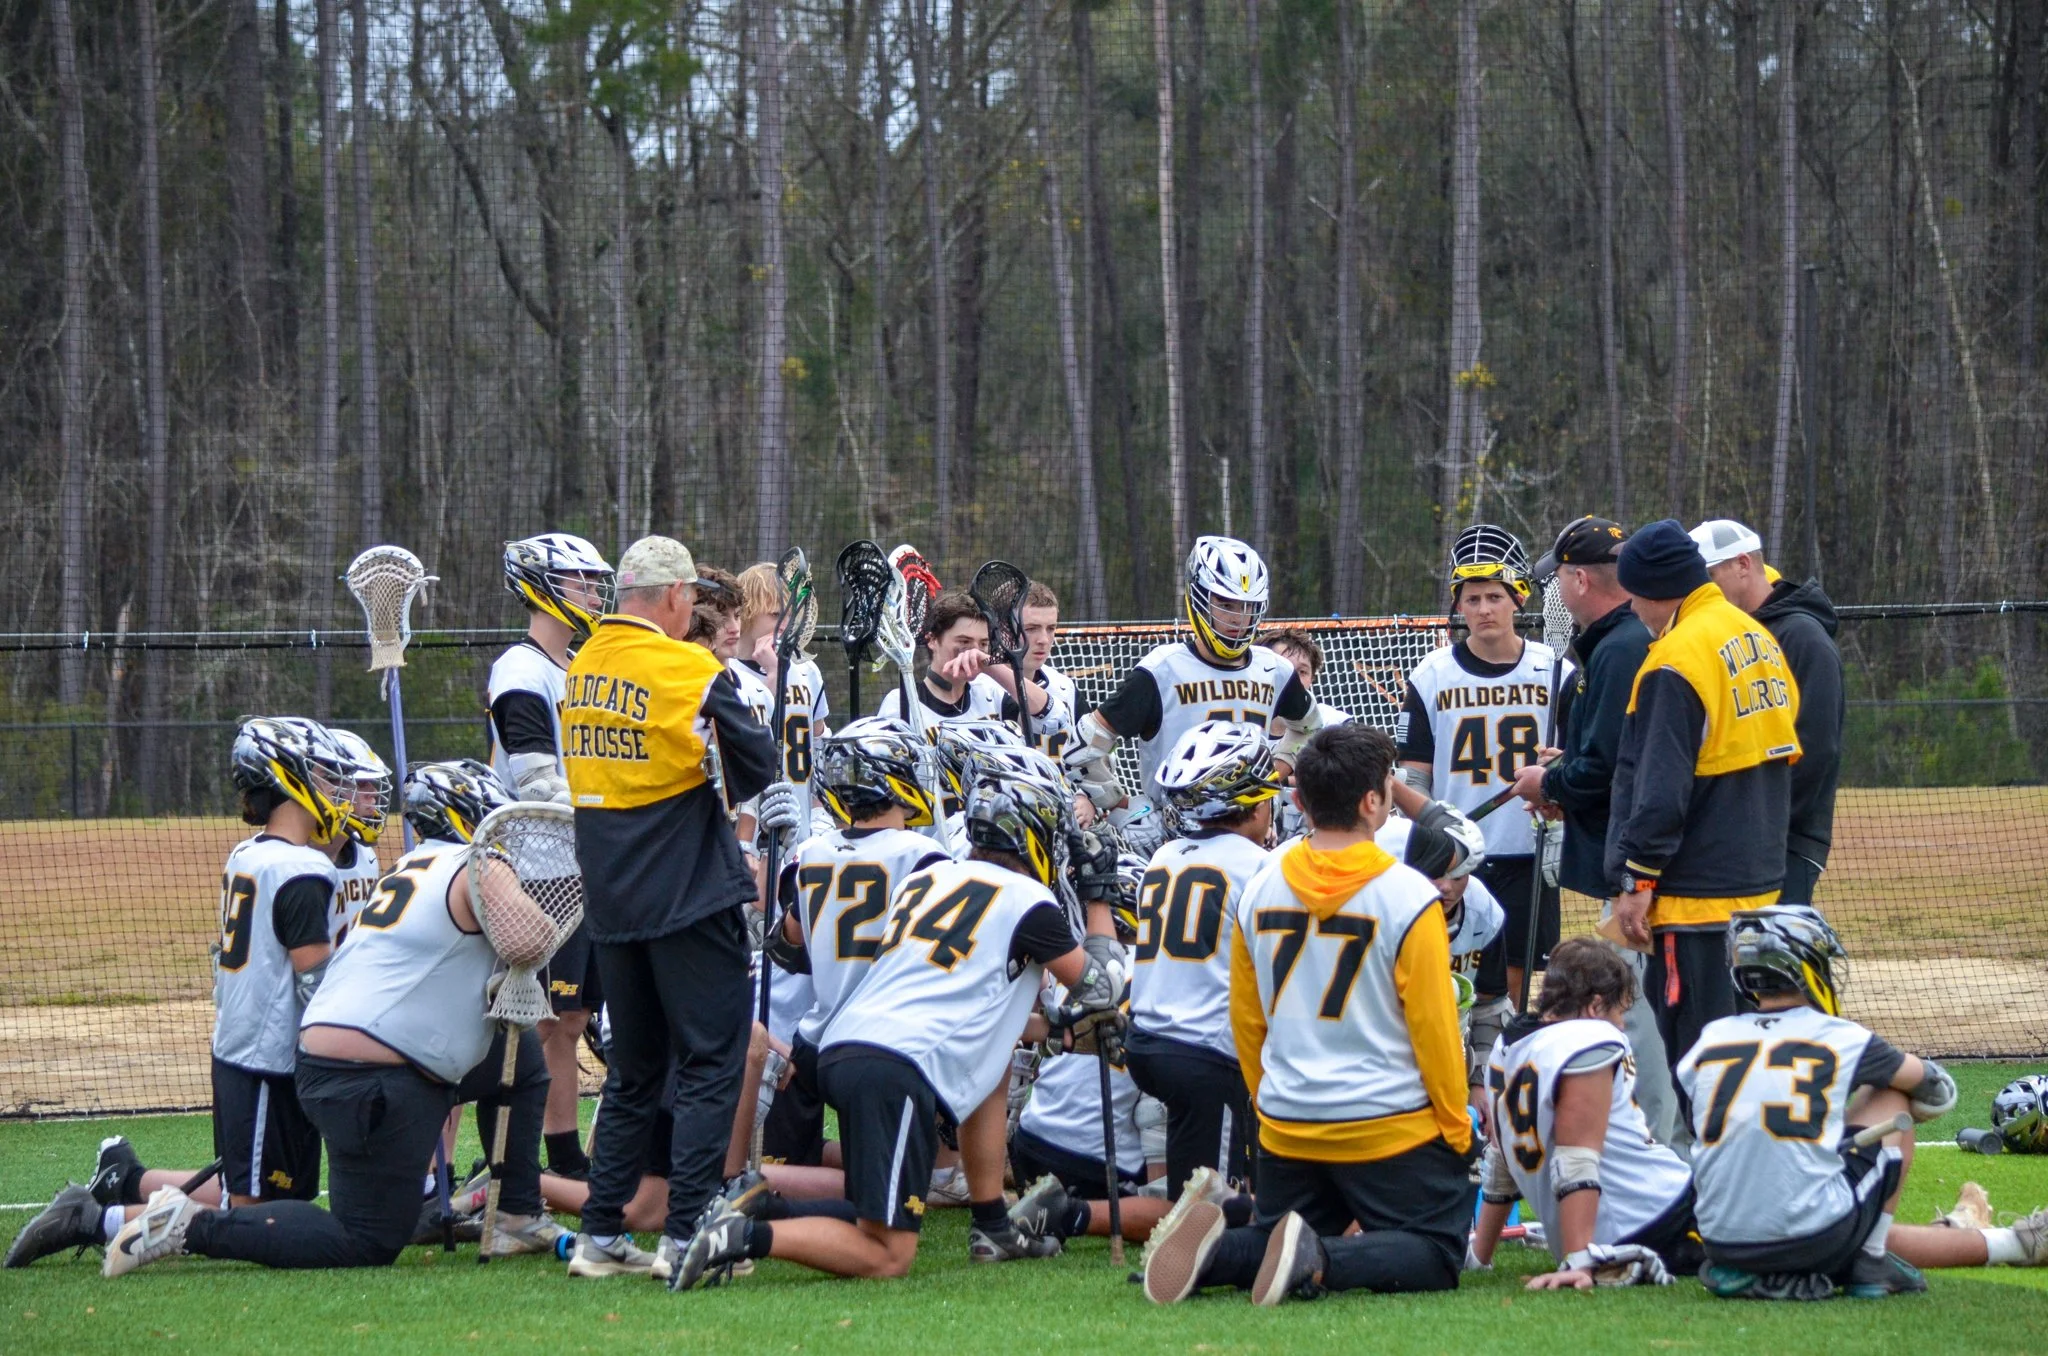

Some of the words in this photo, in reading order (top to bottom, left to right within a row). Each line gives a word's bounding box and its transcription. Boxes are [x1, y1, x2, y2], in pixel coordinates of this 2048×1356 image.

[1174, 679, 1275, 706] WILDCATS
[1436, 683, 1549, 712] WILDCATS
[1450, 714, 1541, 787] 48
[799, 861, 890, 961] 72
[1254, 906, 1379, 1021] 77
[1694, 1039, 1840, 1147] 73
